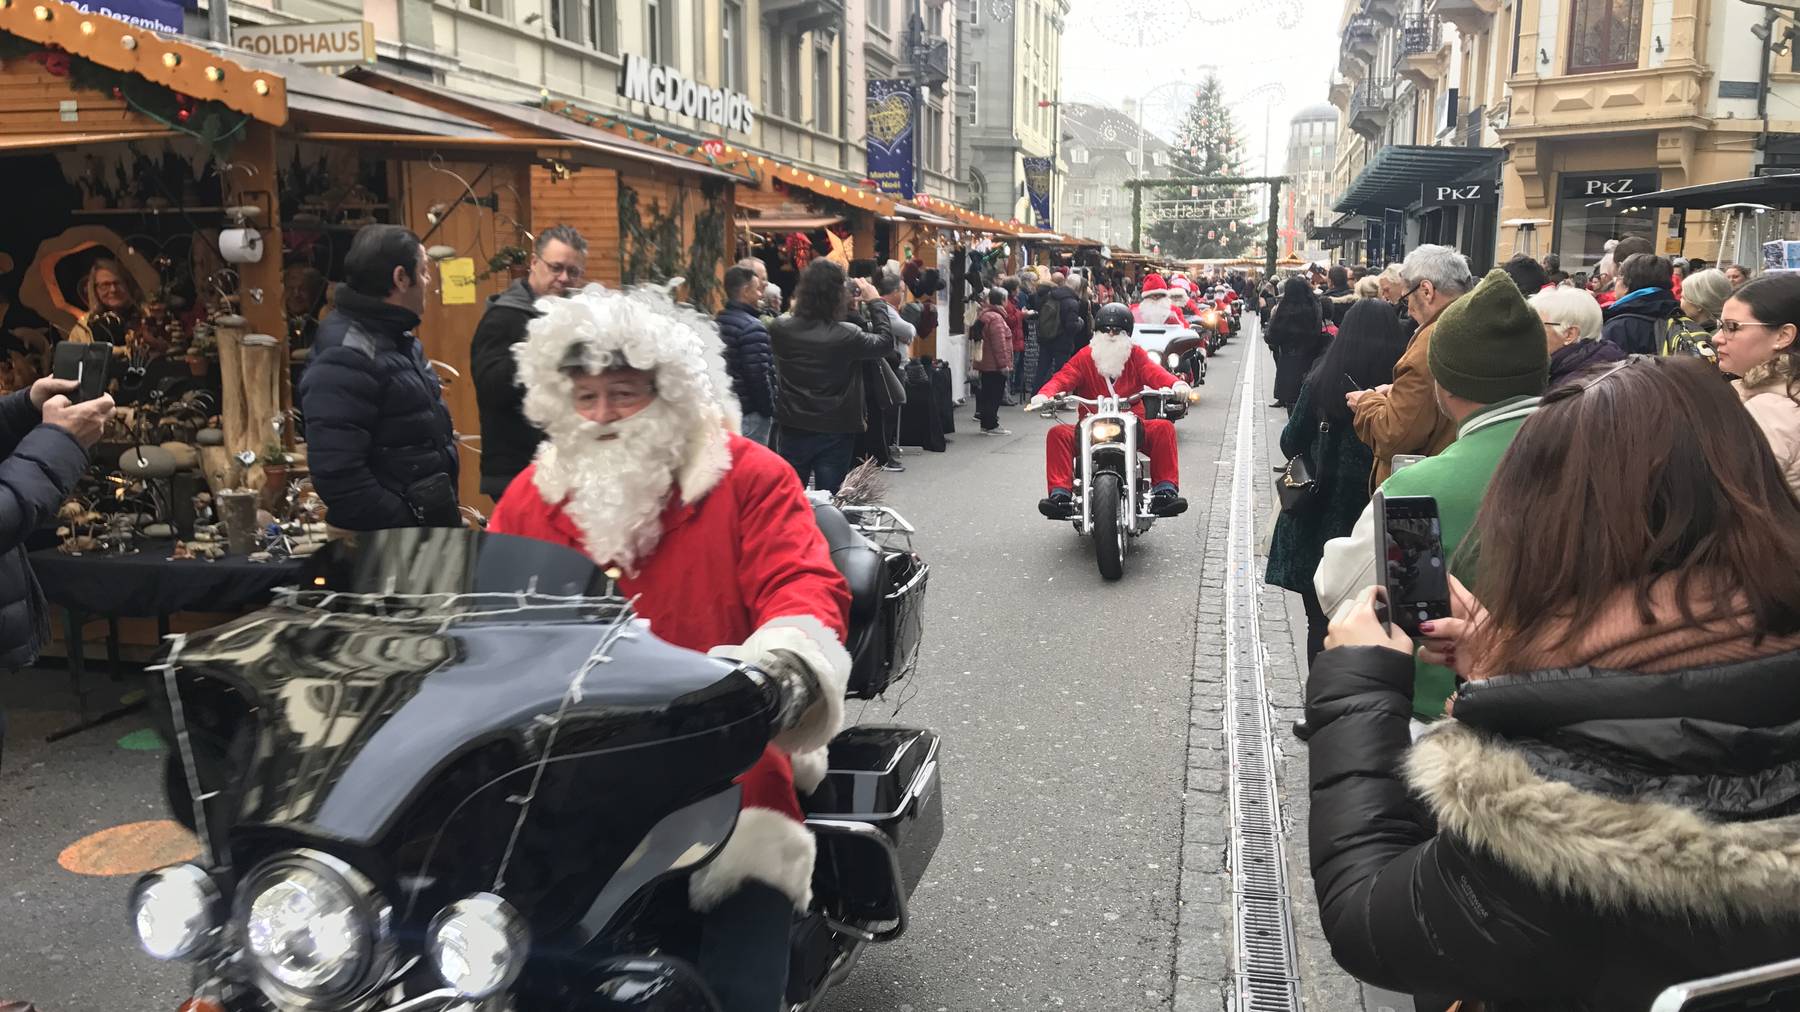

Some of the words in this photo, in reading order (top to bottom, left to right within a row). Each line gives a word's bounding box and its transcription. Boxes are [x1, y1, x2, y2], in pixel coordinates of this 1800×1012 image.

[238, 31, 361, 55] GOLDHAUS
[625, 55, 753, 136] McDonald's
[1436, 186, 1481, 200] PKZ
[1584, 179, 1633, 195] PKZ
